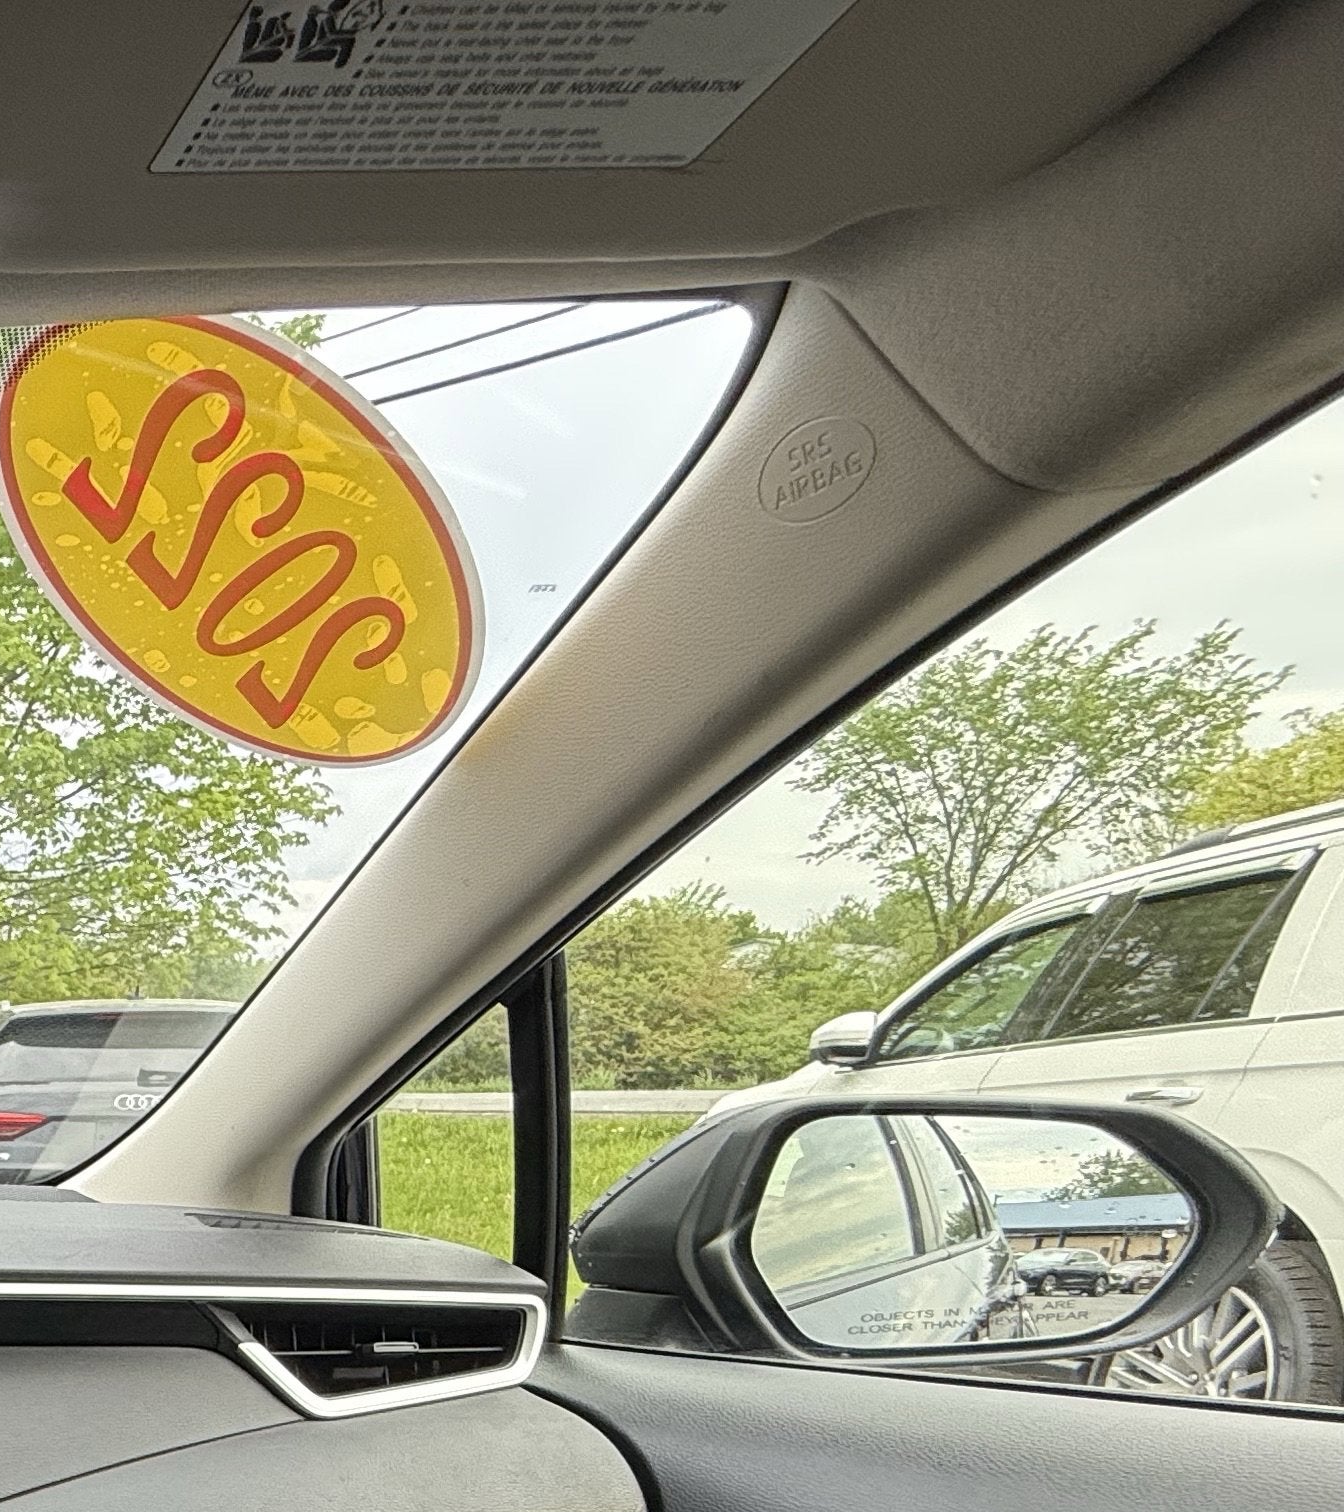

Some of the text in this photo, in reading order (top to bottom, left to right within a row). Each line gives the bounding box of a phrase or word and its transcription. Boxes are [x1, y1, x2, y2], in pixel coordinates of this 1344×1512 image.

[231, 83, 275, 99] MÊME
[278, 84, 319, 98] AVEC
[323, 83, 355, 98] DES
[359, 82, 434, 97] COUSSINS
[436, 82, 462, 96] DE
[539, 81, 564, 95] DE
[567, 80, 642, 95] NOUVELLE
[787, 431, 832, 474] SRS
[773, 451, 864, 511] AIRBAG
[847, 1322, 914, 1335] CLOSER
[922, 1319, 967, 1331] THAN
[1025, 1310, 1089, 1323] PPEAR
[860, 1309, 935, 1324] OBJECTS
[943, 1307, 960, 1317] IN
[1043, 1299, 1076, 1310] ARE
